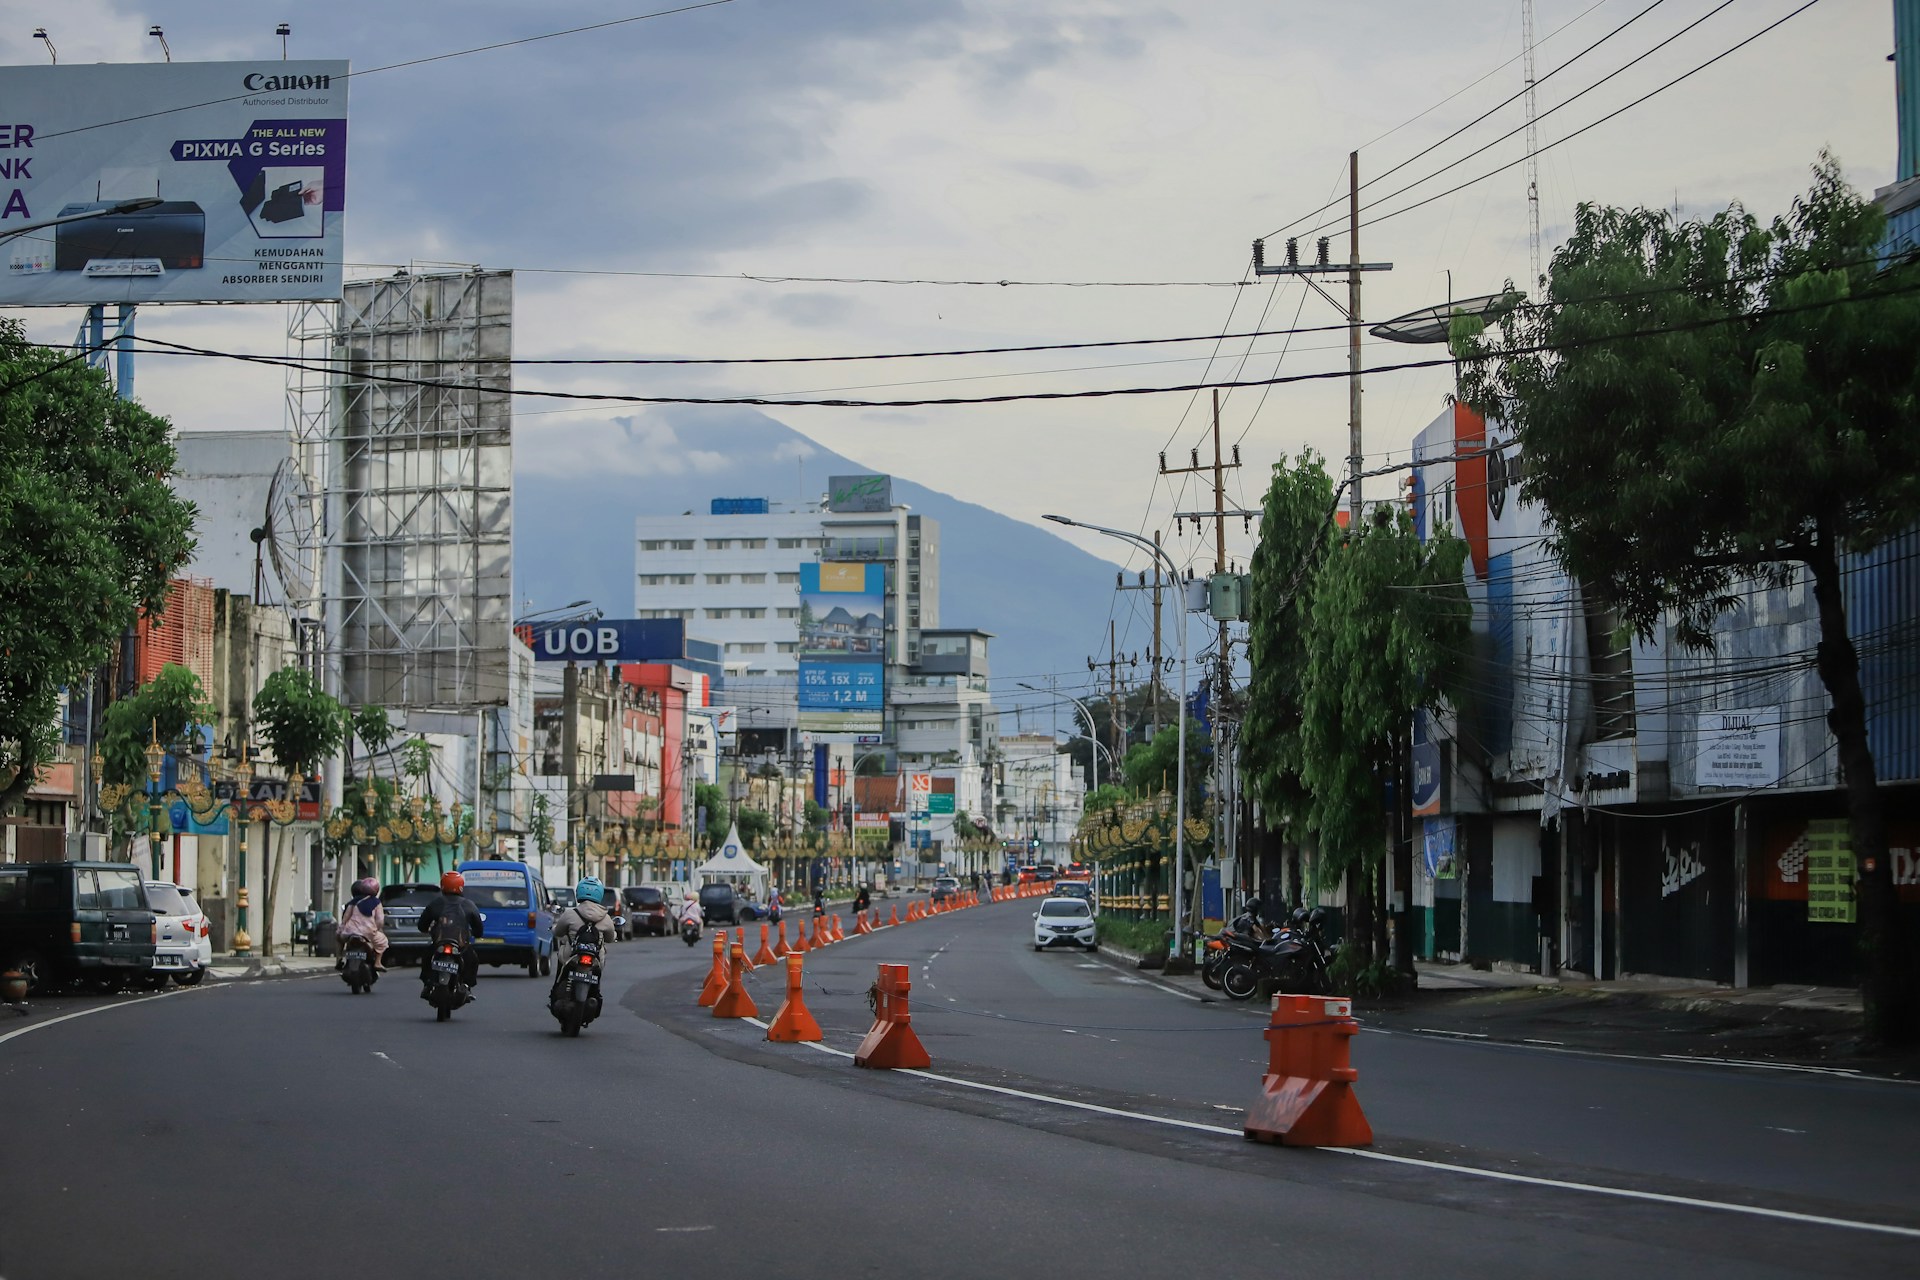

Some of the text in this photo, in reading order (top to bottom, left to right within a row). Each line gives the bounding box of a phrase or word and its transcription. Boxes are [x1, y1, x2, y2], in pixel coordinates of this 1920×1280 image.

[243, 73, 330, 90] Canon
[242, 97, 329, 106] Authorised Distributor
[252, 128, 326, 137] THE ALL NEW
[182, 141, 325, 158] PIXMA G Series
[254, 248, 324, 257] KEMUDAHAN
[258, 261, 324, 270] MENGGANTI
[222, 274, 323, 284] ABSORBER SENDIRI
[544, 627, 620, 655] UOB
[805, 676, 827, 685] 15%
[832, 676, 850, 685] 15X
[858, 676, 875, 685] 27X
[834, 690, 867, 703] 1,2 M
